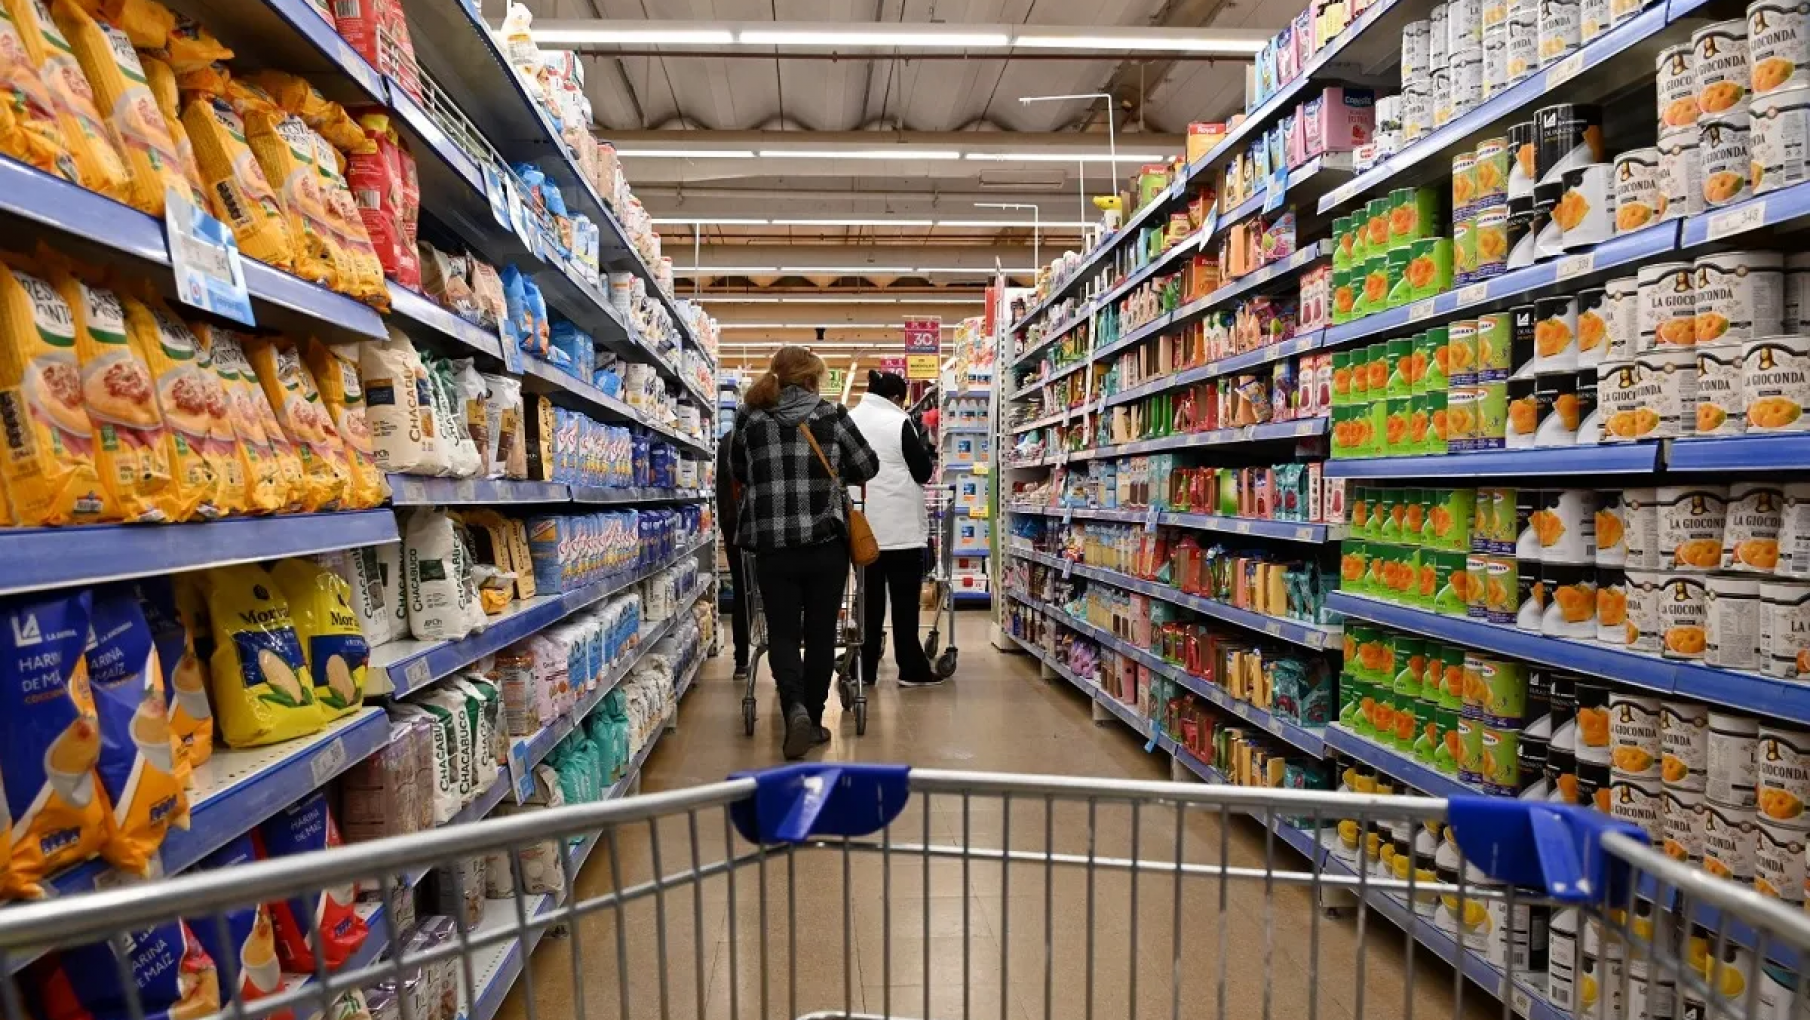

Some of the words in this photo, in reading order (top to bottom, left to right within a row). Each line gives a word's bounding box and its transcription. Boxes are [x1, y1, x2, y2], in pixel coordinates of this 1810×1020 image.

[1666, 76, 1693, 92] GIOCO
[1665, 294, 1696, 307] GIOCO
[1752, 371, 1806, 385] GIOCONDA
[1611, 389, 1636, 401] GIOC
[1669, 518, 1681, 529] LA
[1682, 517, 1726, 529] GIOCOND
[409, 548, 423, 612] CHACABUCO
[91, 646, 125, 669] ARINA
[22, 678, 41, 692] DE
[434, 725, 449, 792] CHACABU
[459, 710, 470, 795] CHACABUCO
[132, 939, 168, 973] ARINA
